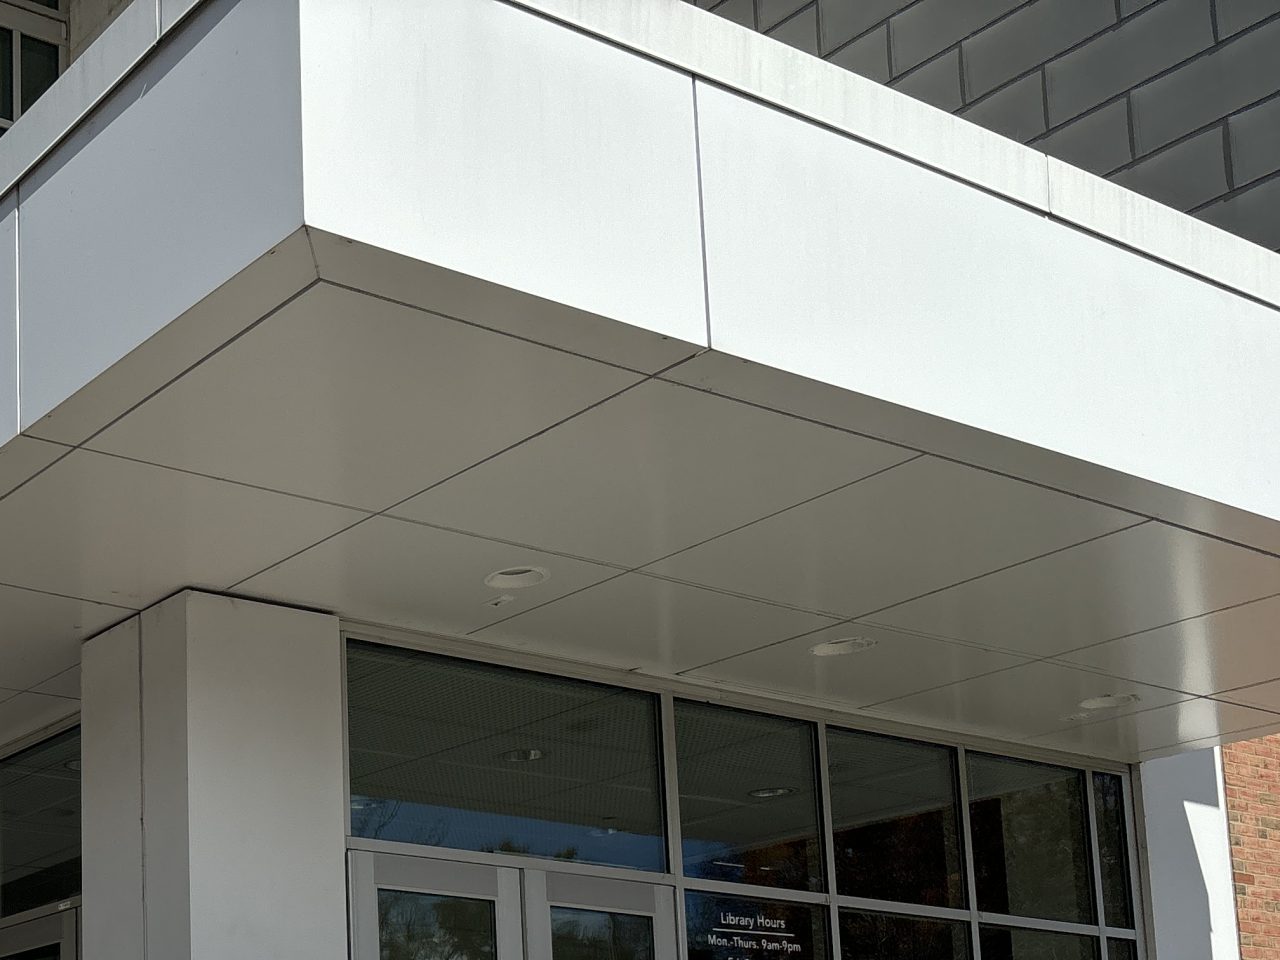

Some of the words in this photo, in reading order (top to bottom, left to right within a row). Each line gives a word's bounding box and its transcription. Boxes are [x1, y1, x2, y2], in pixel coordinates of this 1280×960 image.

[720, 911, 754, 929] Library
[757, 914, 786, 928] Hours
[707, 934, 760, 949] Mon.-Thurs.
[761, 938, 802, 954] 9am-9pm
